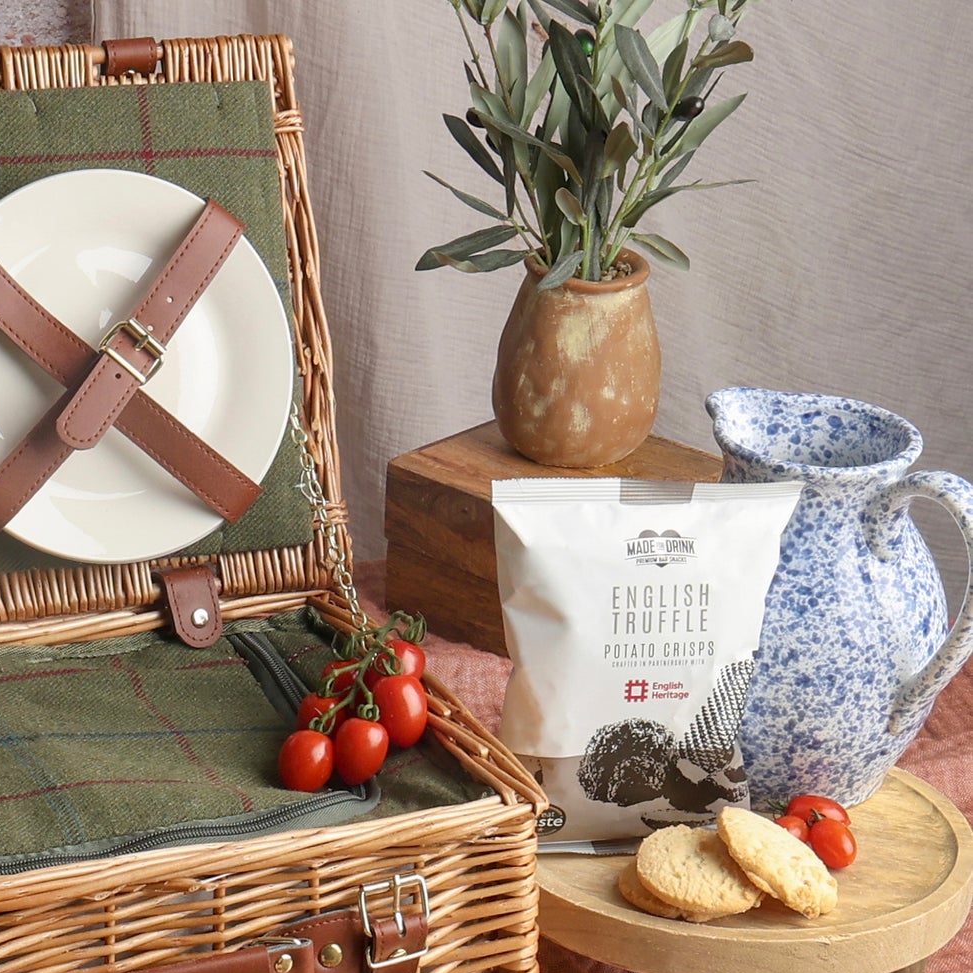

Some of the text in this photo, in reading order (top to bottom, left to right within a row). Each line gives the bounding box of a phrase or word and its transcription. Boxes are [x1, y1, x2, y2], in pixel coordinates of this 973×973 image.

[627, 540, 655, 556] MADE
[666, 540, 695, 554] DRINK
[612, 583, 709, 609] ENGLISH
[612, 609, 708, 635] TRUFFLE
[604, 641, 715, 659] POTATO CRISPS
[652, 682, 684, 691] English
[652, 691, 689, 700] Heritage
[538, 817, 563, 827] ste
